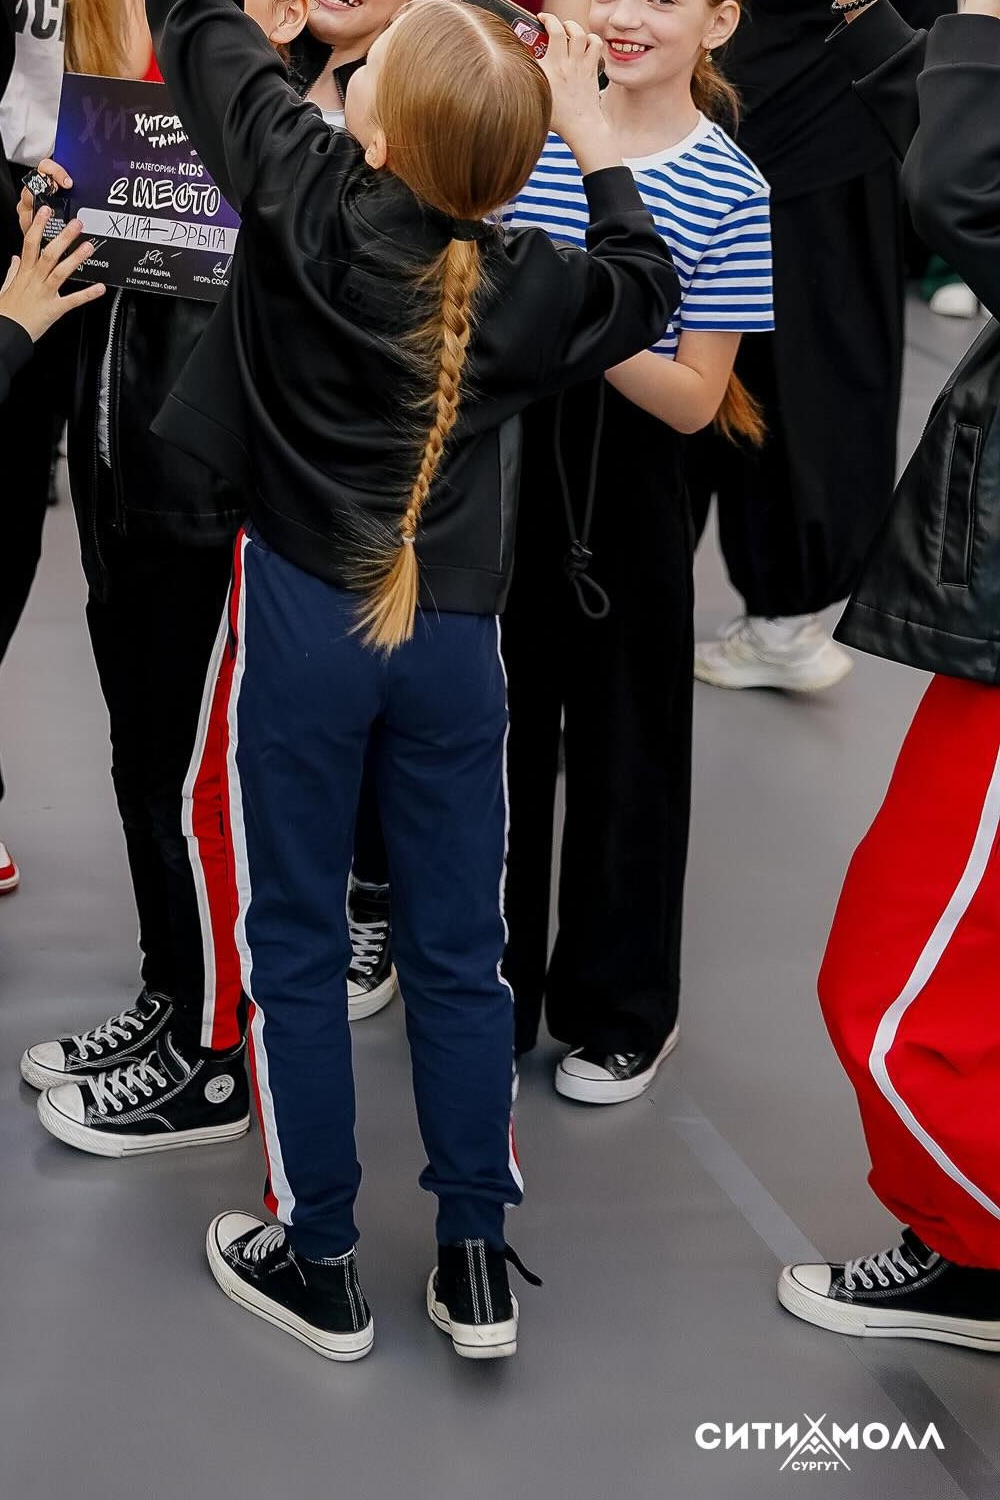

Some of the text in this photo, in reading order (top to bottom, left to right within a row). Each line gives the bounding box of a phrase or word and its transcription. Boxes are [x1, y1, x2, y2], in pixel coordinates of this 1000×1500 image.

[130, 160, 204, 178] В КАТЕГОРИИ: KIDS
[108, 176, 220, 217] 2 МЕСТО
